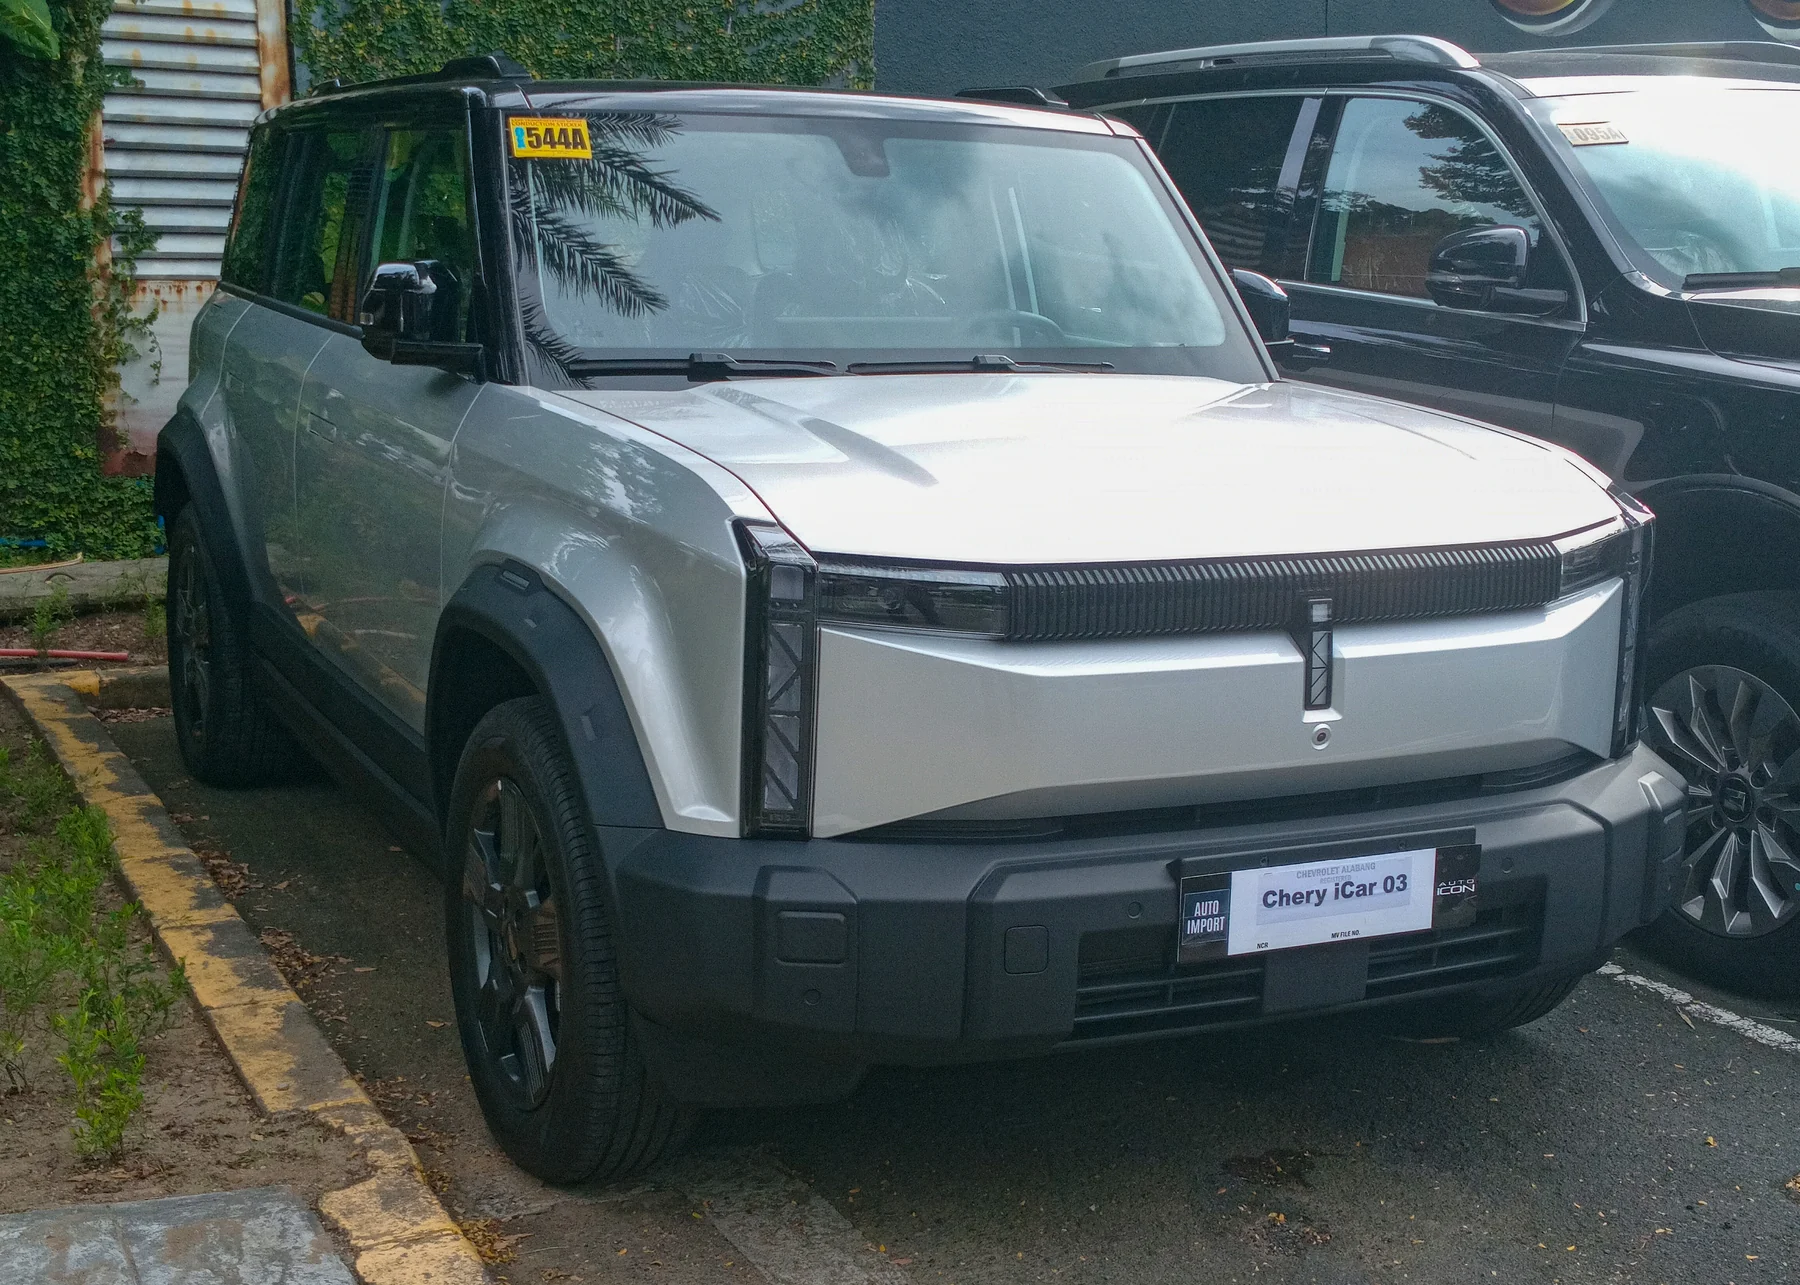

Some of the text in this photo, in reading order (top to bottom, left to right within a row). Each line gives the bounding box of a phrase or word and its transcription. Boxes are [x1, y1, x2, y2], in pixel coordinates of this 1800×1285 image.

[527, 127, 588, 150] 544A
[1297, 862, 1376, 879] CHEVROLET ALABANG
[1262, 874, 1408, 908] Chery iCar 03
[1194, 900, 1219, 917] AUTO
[1187, 917, 1225, 935] IMPORT
